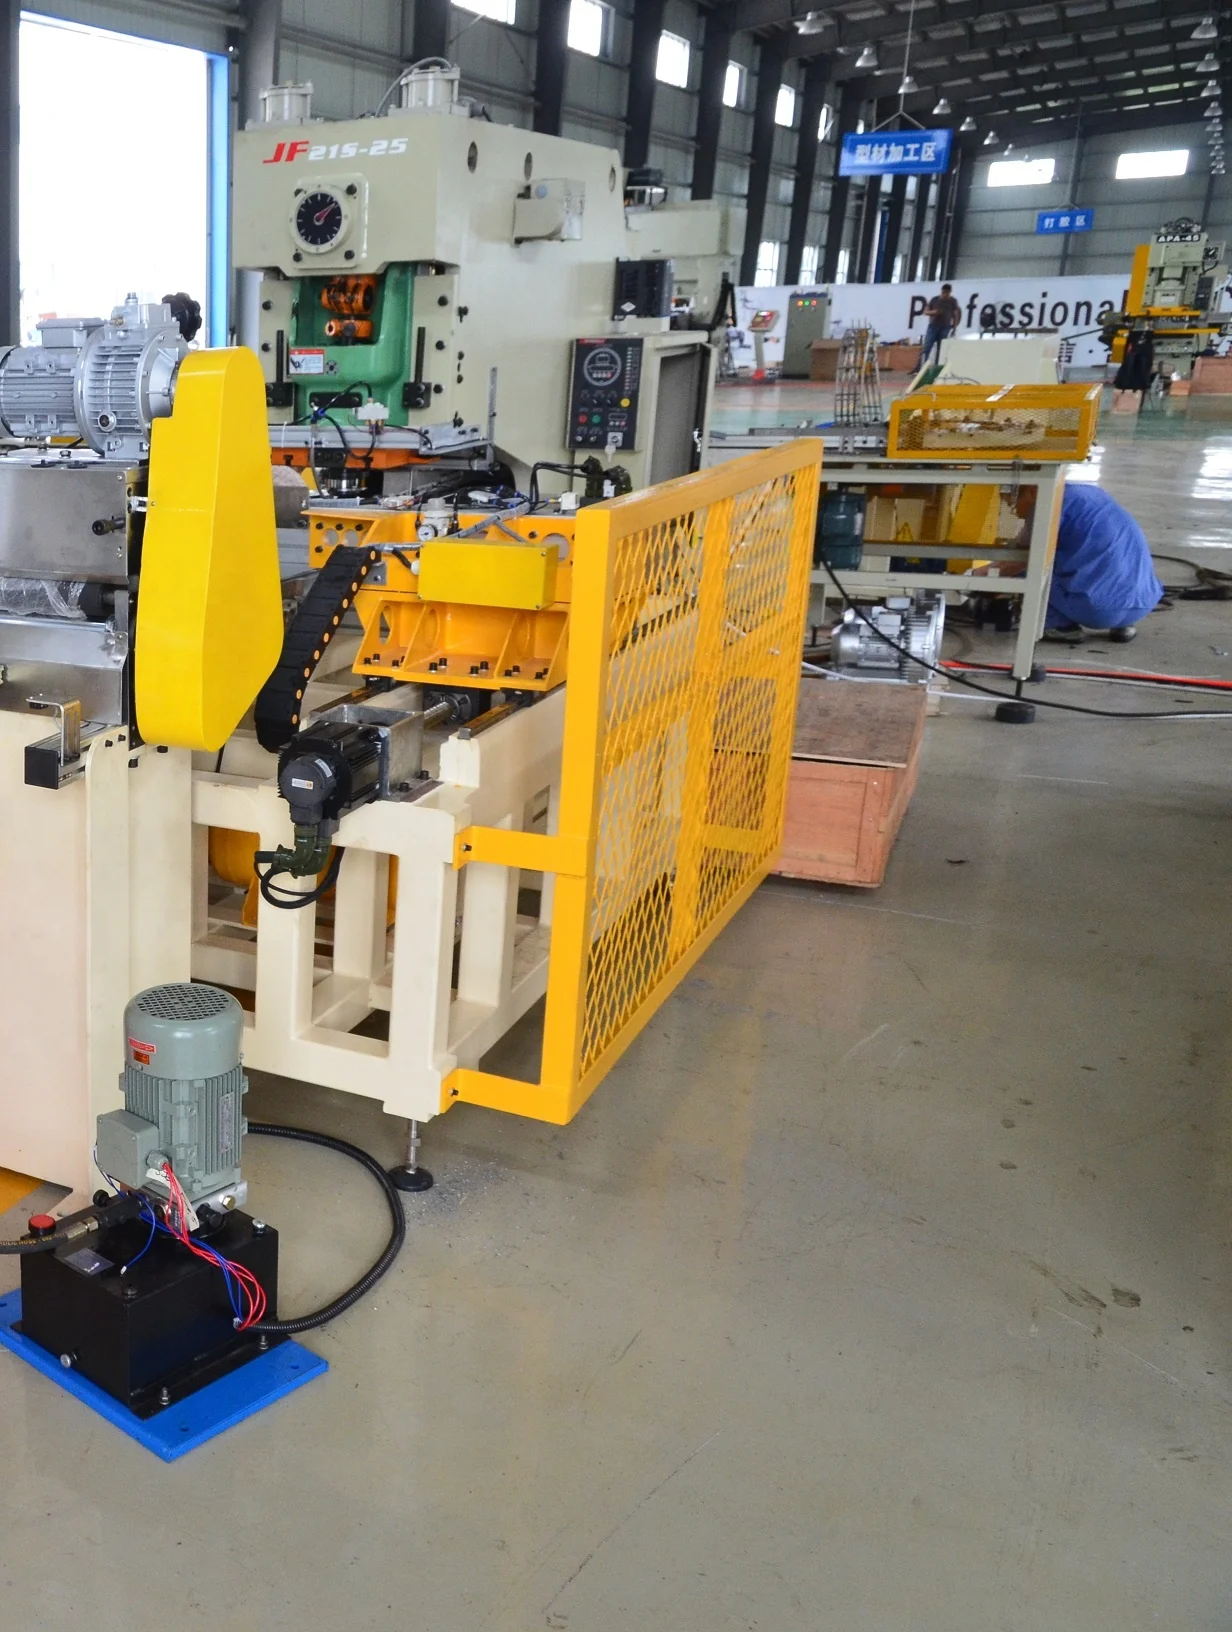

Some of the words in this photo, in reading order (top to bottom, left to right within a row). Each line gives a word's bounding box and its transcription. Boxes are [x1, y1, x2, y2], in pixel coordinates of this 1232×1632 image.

[854, 142, 937, 164] 型材加工区
